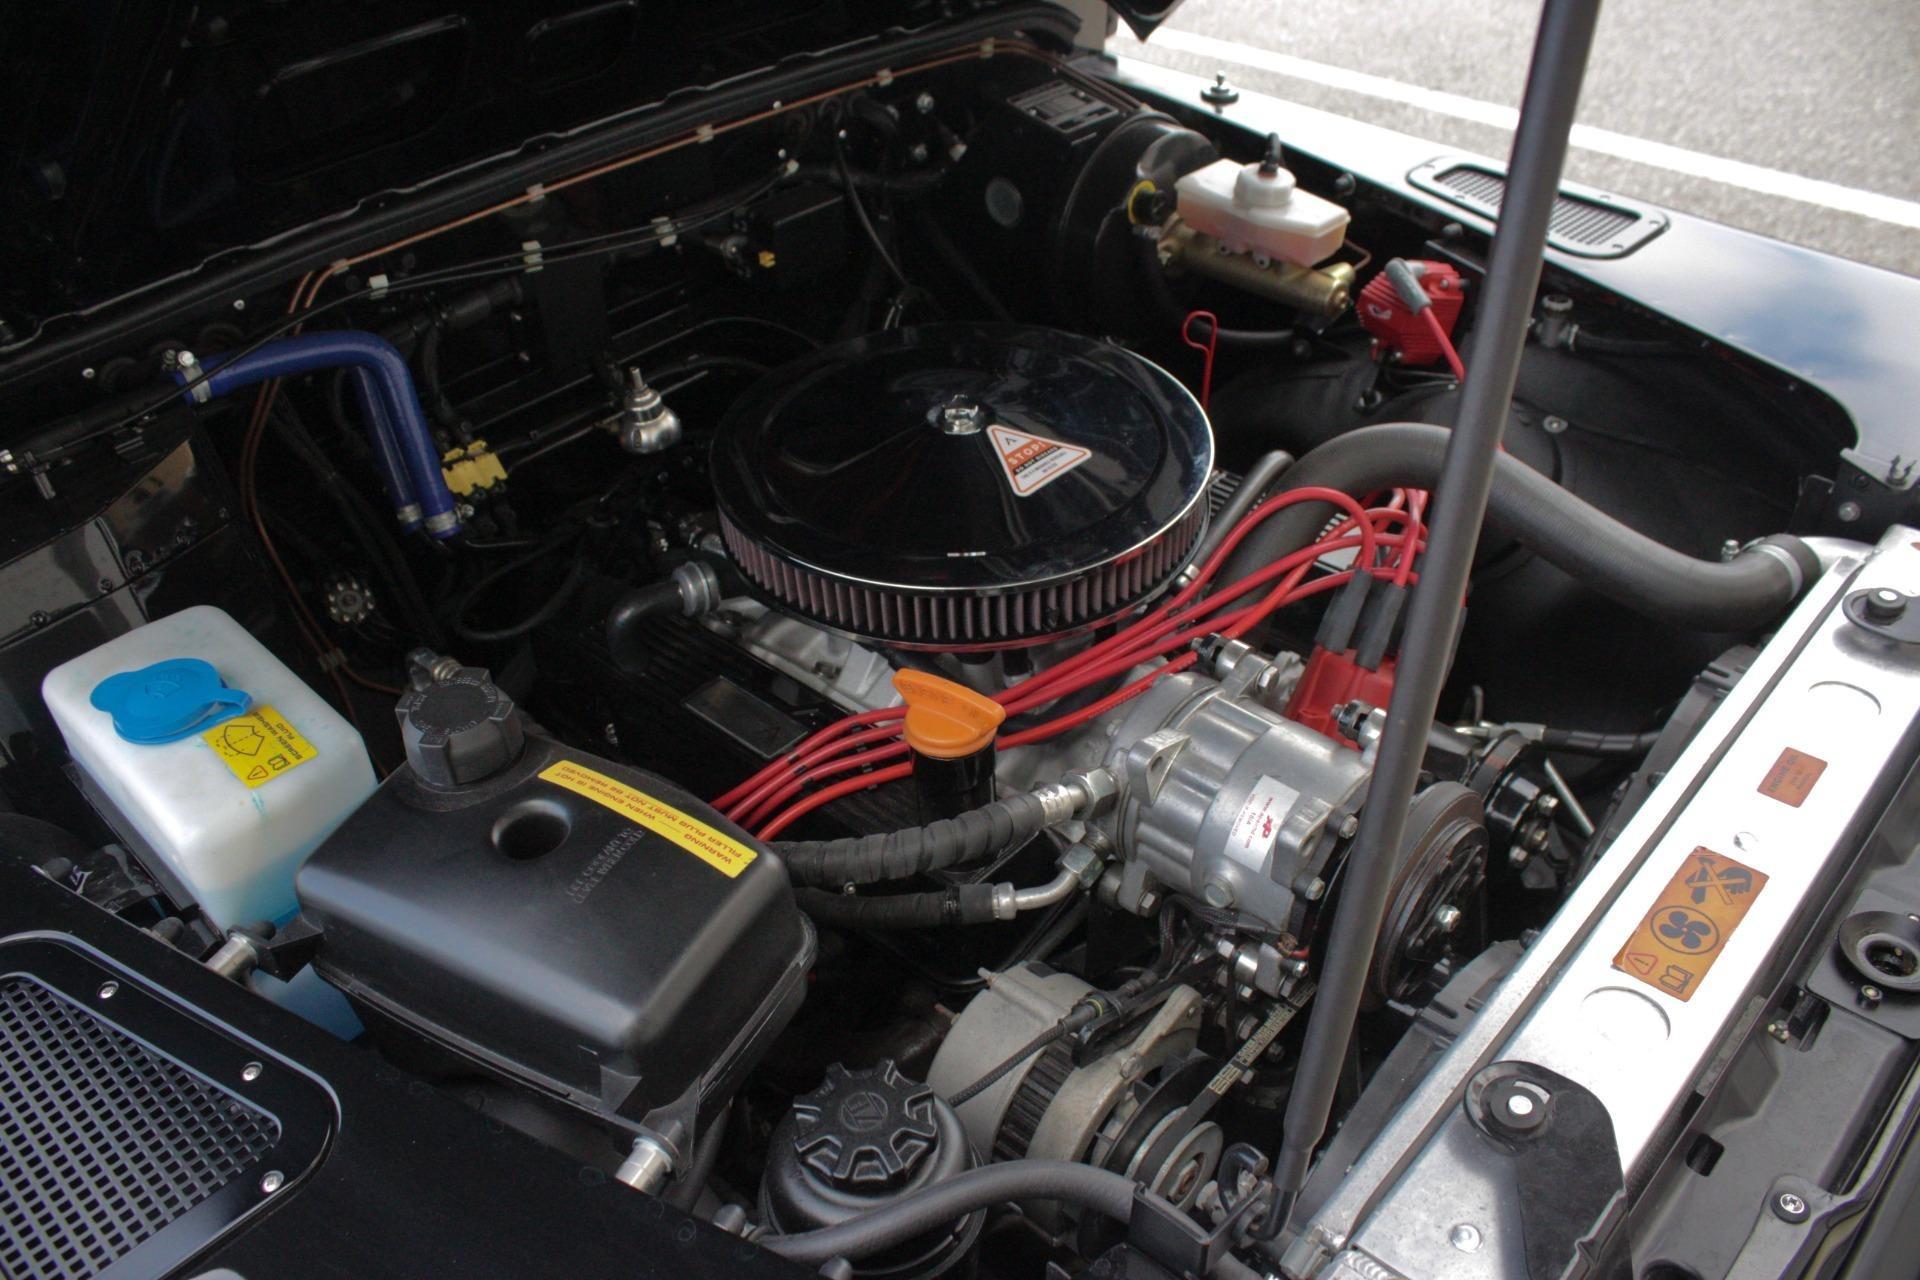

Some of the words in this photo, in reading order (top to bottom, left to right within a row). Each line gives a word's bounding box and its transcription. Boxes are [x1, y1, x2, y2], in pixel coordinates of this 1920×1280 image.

[1008, 441, 1047, 465] STOP!
[276, 722, 296, 740] FLUID
[279, 735, 304, 760] SCREEN
[555, 772, 575, 782] HOT
[562, 766, 608, 787] REMOVED
[589, 786, 624, 804] ENGINE
[610, 786, 624, 795] BE
[625, 793, 647, 806] NOT
[626, 803, 656, 820] WHEN
[646, 804, 679, 822] MUST
[679, 820, 706, 837] PLUG
[684, 833, 732, 864] WARNING
[708, 836, 742, 858] FILLER
